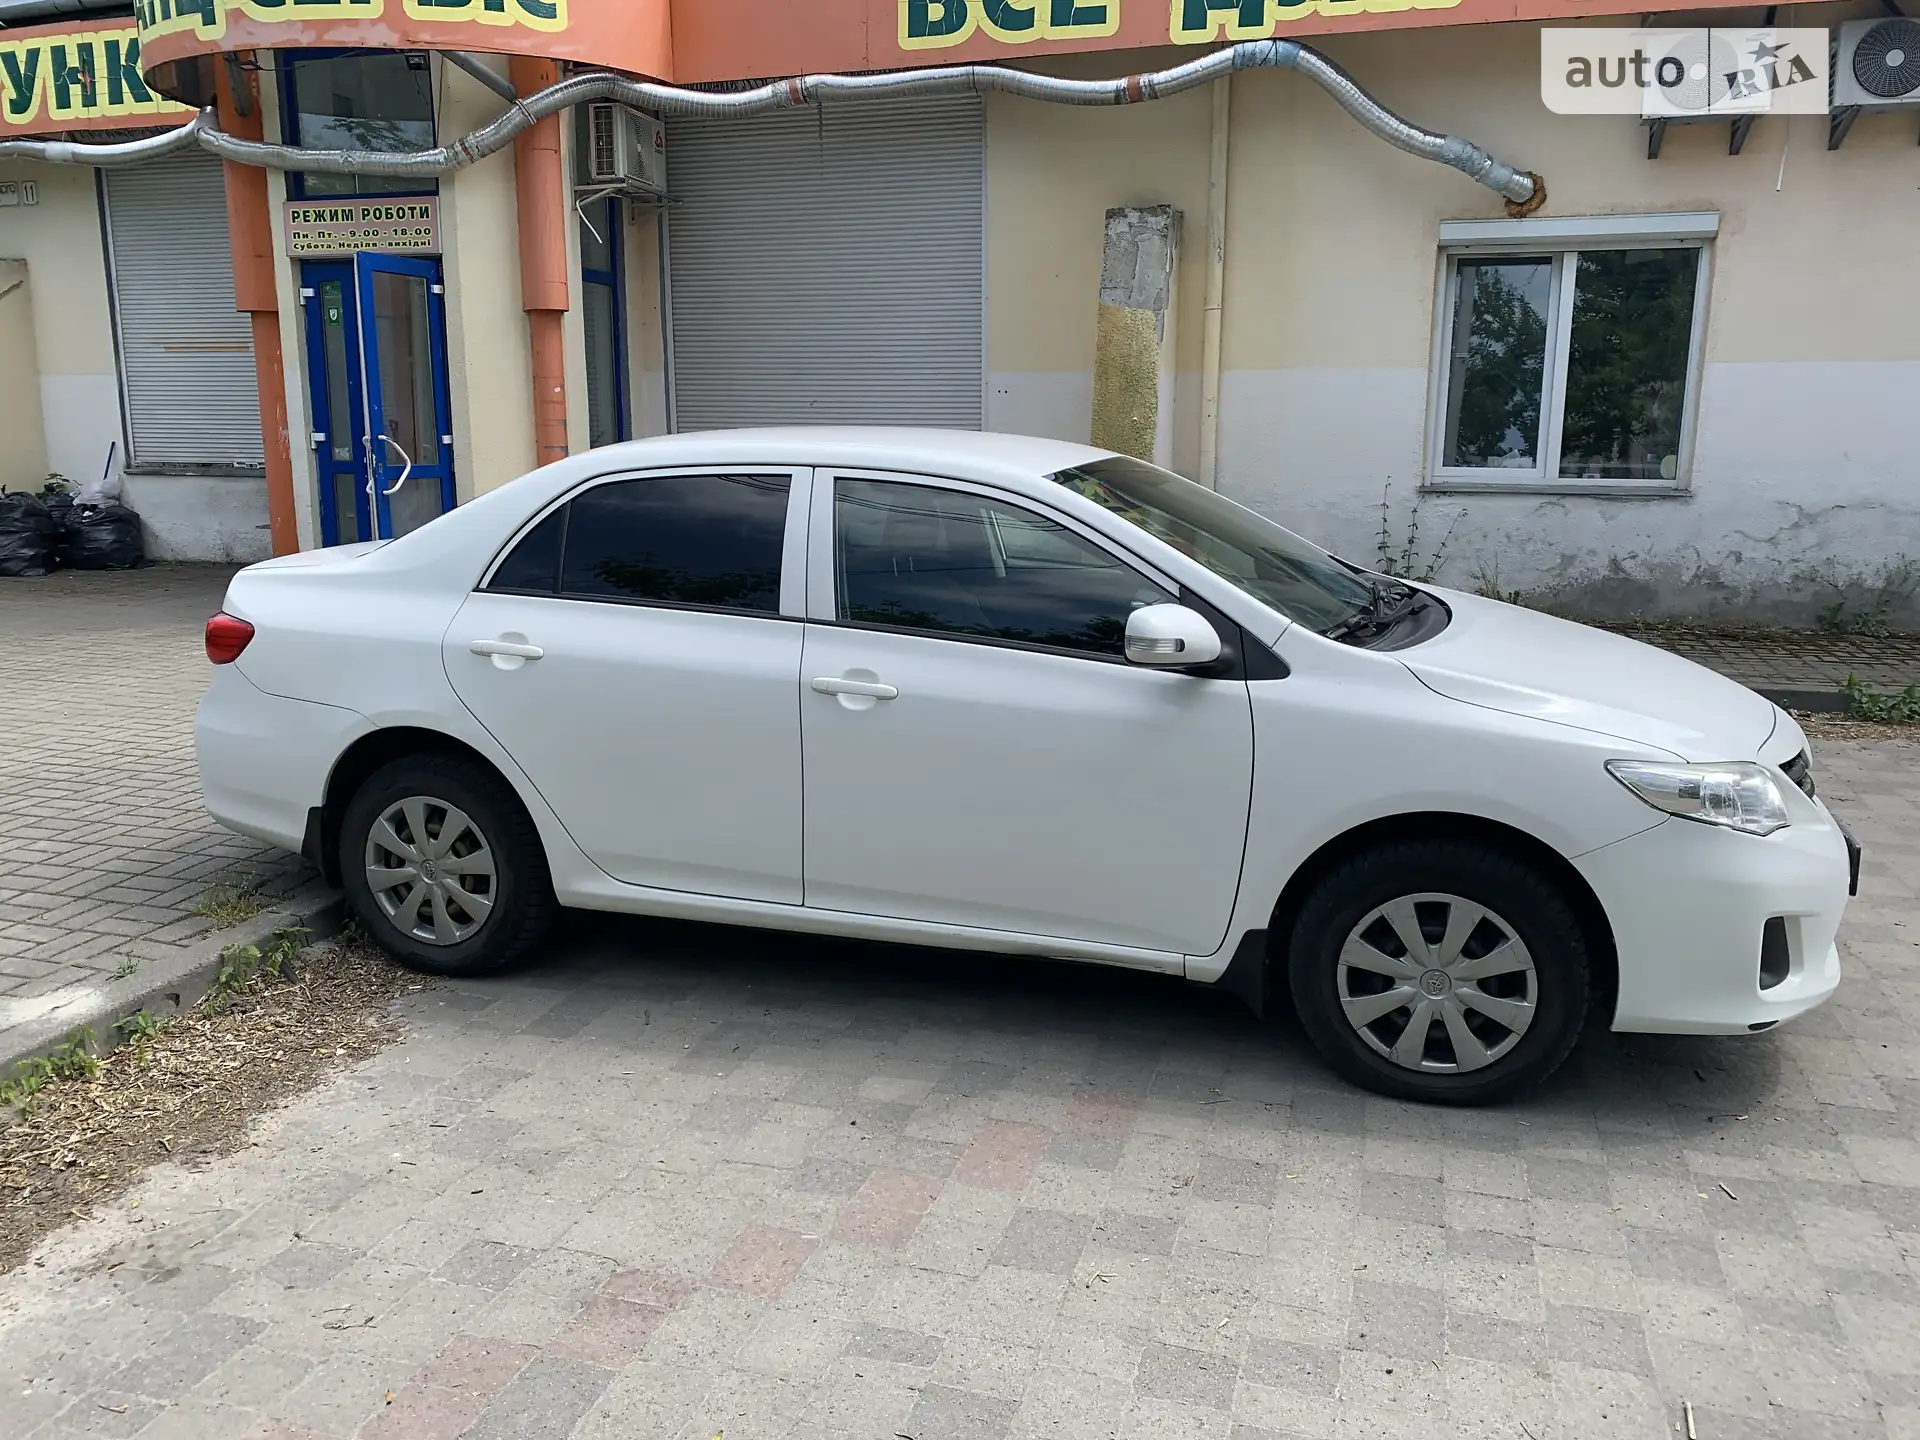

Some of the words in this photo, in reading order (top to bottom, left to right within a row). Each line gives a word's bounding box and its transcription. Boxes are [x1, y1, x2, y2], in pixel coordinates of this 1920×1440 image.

[0, 38, 176, 115] УНК
[24, 184, 35, 202] 11
[291, 208, 354, 223] РЕЖИМ
[361, 206, 430, 221] РОБОТИ
[292, 231, 314, 240] Пн.
[317, 231, 338, 239] Пт.
[349, 229, 380, 238] 9.00
[392, 227, 432, 236] 18.00
[293, 242, 336, 251] Субота,
[338, 240, 378, 249] Неділя
[387, 238, 432, 248] вихідні
